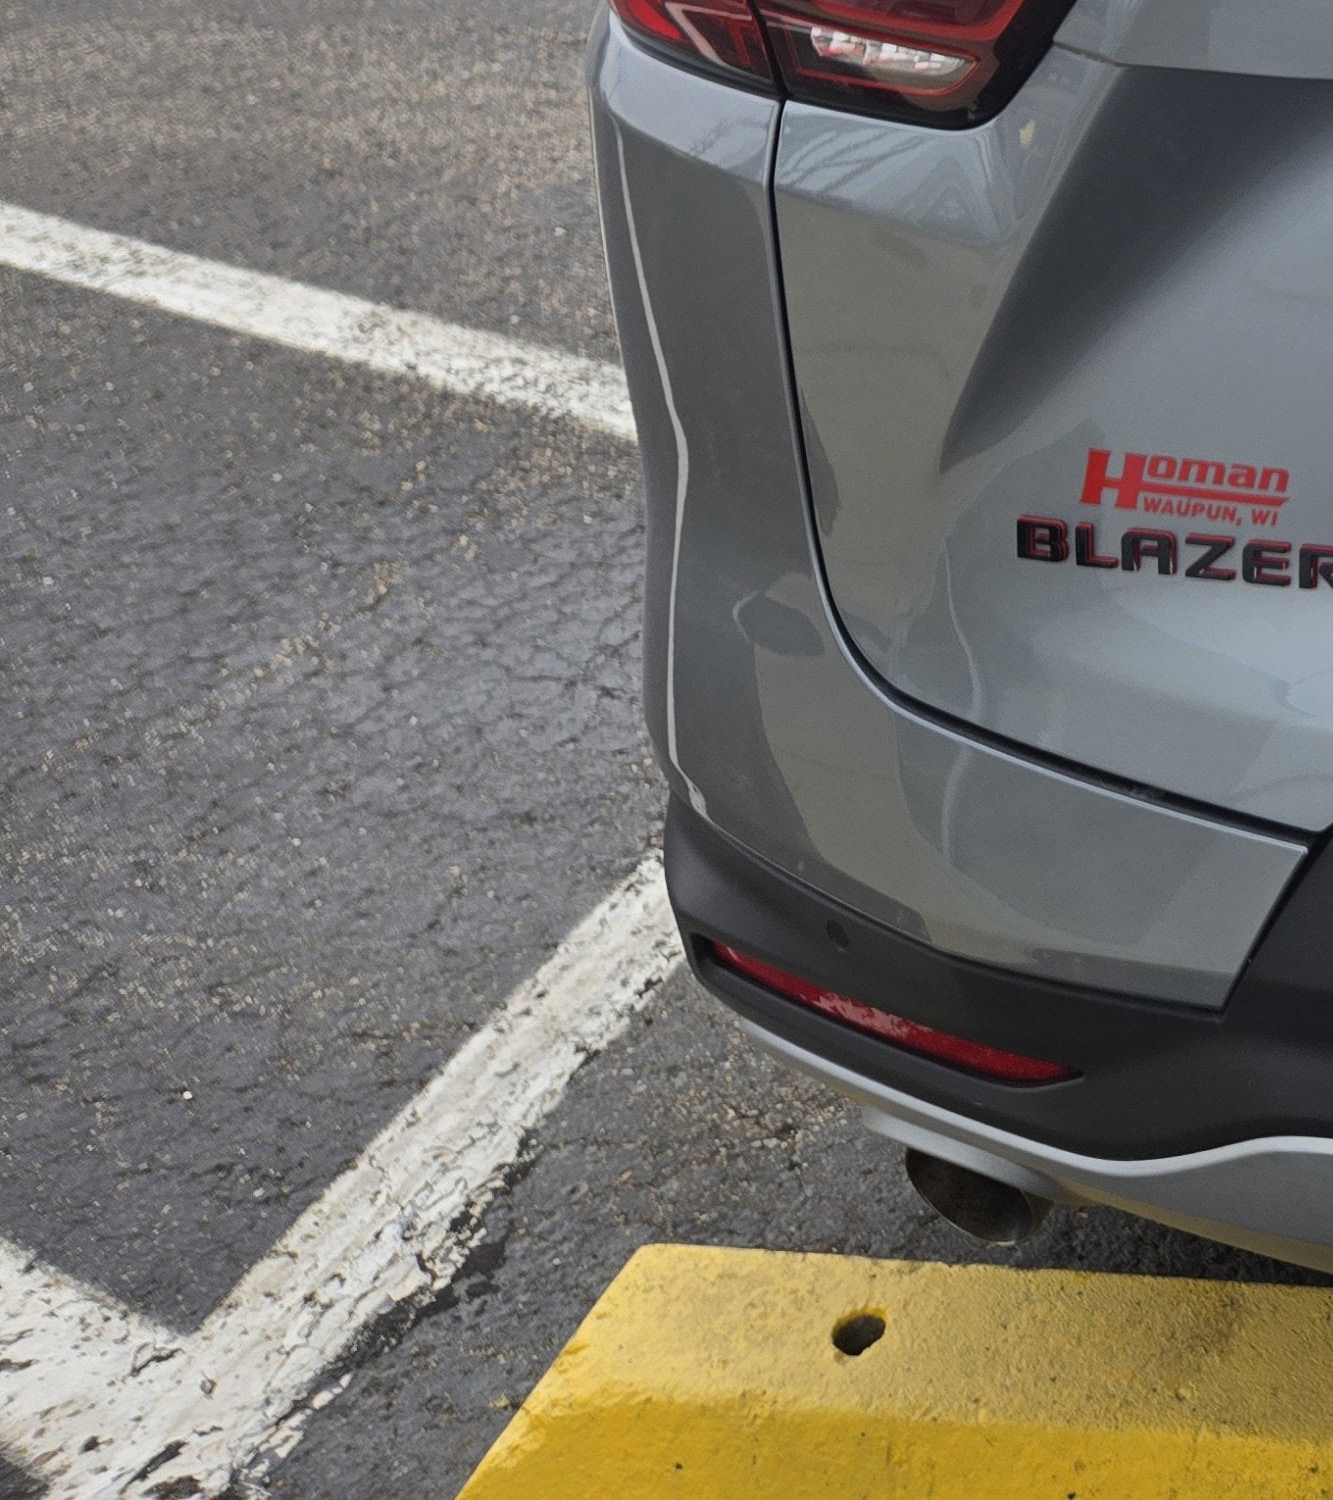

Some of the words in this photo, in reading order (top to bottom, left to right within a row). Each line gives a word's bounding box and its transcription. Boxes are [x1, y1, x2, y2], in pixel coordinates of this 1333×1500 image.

[1080, 448, 1290, 510] Homan
[1144, 497, 1242, 526] WAUPUN,
[1251, 510, 1278, 527] WI
